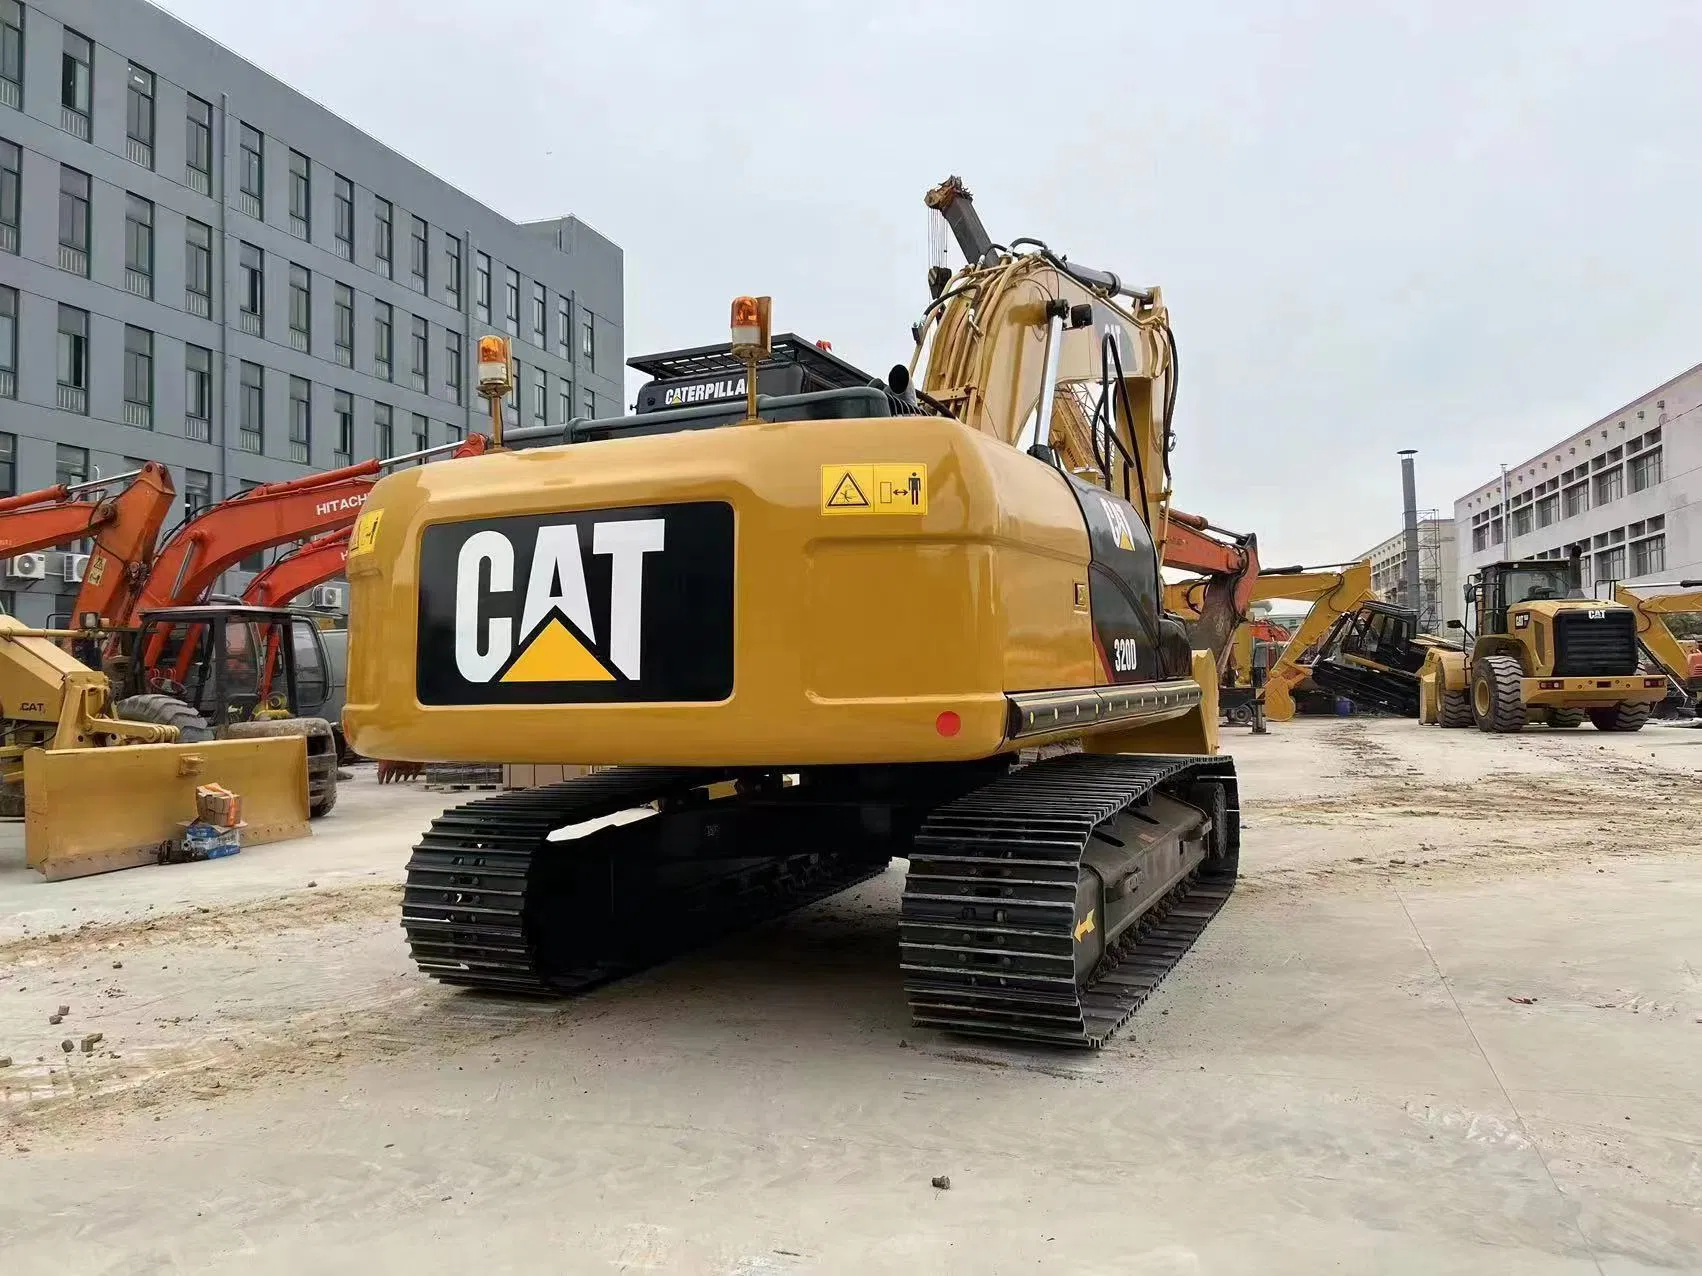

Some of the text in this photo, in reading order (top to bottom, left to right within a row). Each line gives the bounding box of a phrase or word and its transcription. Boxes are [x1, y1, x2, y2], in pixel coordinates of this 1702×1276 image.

[665, 379, 749, 405] CATERPILLA
[316, 493, 369, 516] HITACH
[1100, 497, 1136, 552] CAT
[455, 518, 666, 683] CAT
[1588, 610, 1606, 620] CAT
[1113, 638, 1137, 672] 320D
[21, 702, 44, 712] CAT
